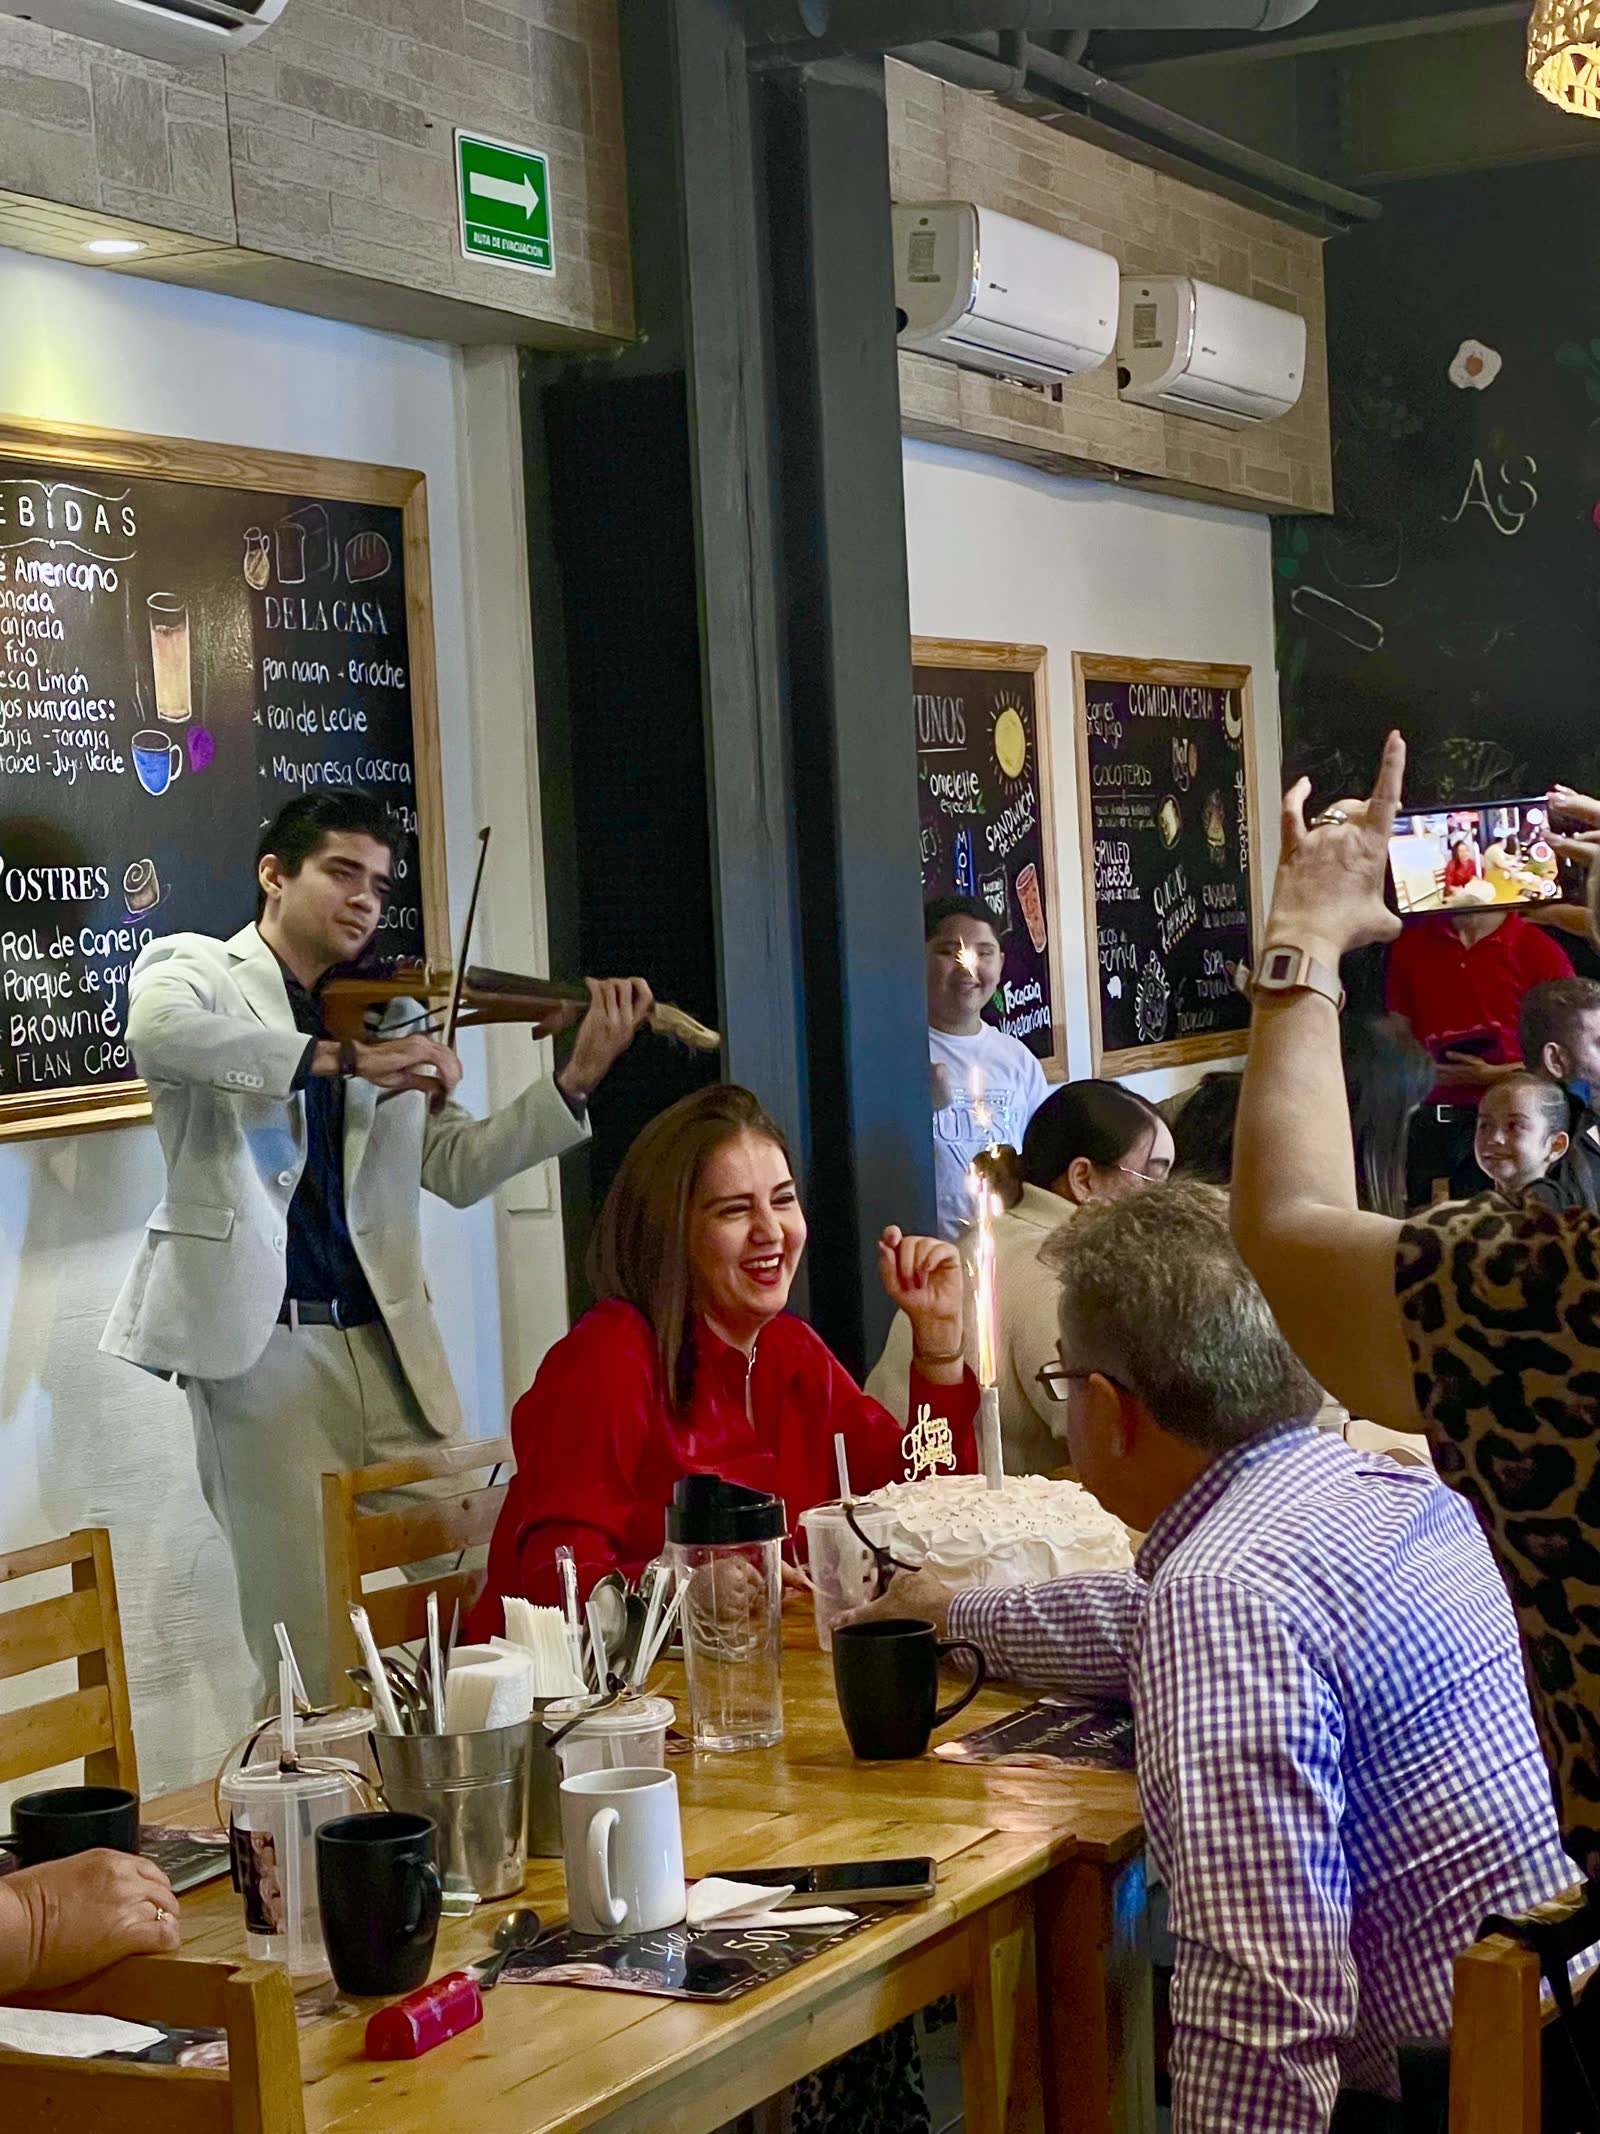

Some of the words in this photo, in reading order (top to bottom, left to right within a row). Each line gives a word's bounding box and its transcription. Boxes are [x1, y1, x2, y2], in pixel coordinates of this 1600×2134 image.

[473, 232, 491, 246] RUTA
[492, 236, 501, 249] DE
[38, 667, 88, 694] Limón
[273, 755, 352, 793] Mayonesa
[355, 757, 411, 785] Casera
[50, 925, 74, 959] de
[78, 964, 100, 993] de
[16, 1050, 72, 1084] FLAN
